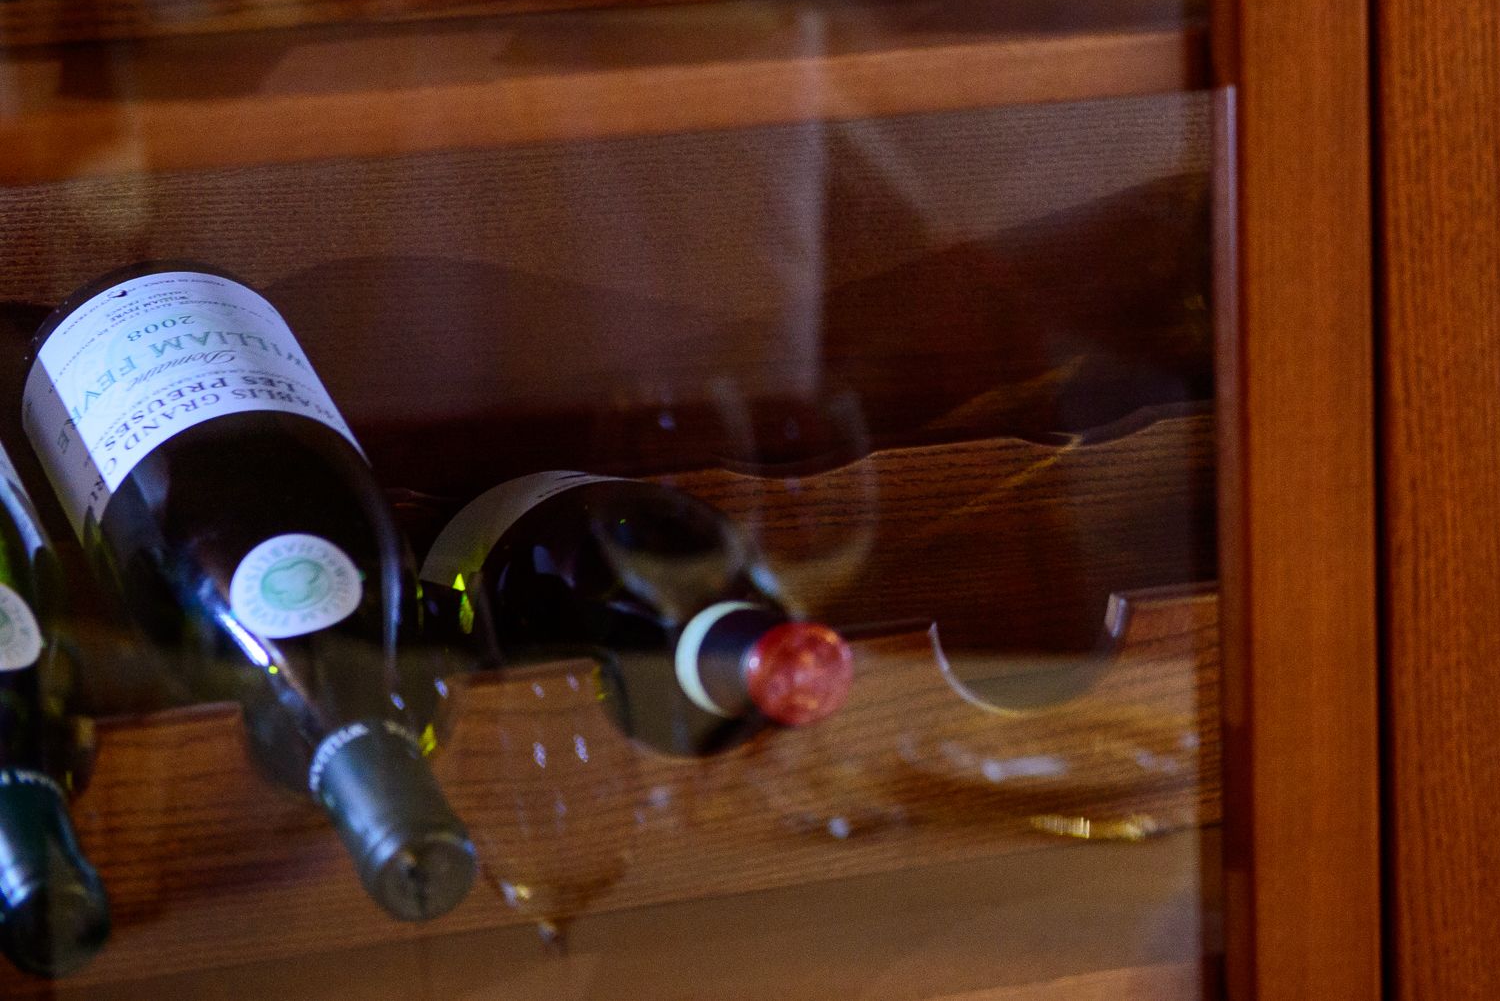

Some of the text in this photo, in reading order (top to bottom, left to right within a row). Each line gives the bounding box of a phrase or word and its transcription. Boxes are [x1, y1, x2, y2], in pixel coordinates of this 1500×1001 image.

[127, 315, 196, 343] 2008
[126, 350, 237, 392] Domaine
[104, 375, 296, 450] LES PREUSES
[124, 393, 220, 451] GRAND
